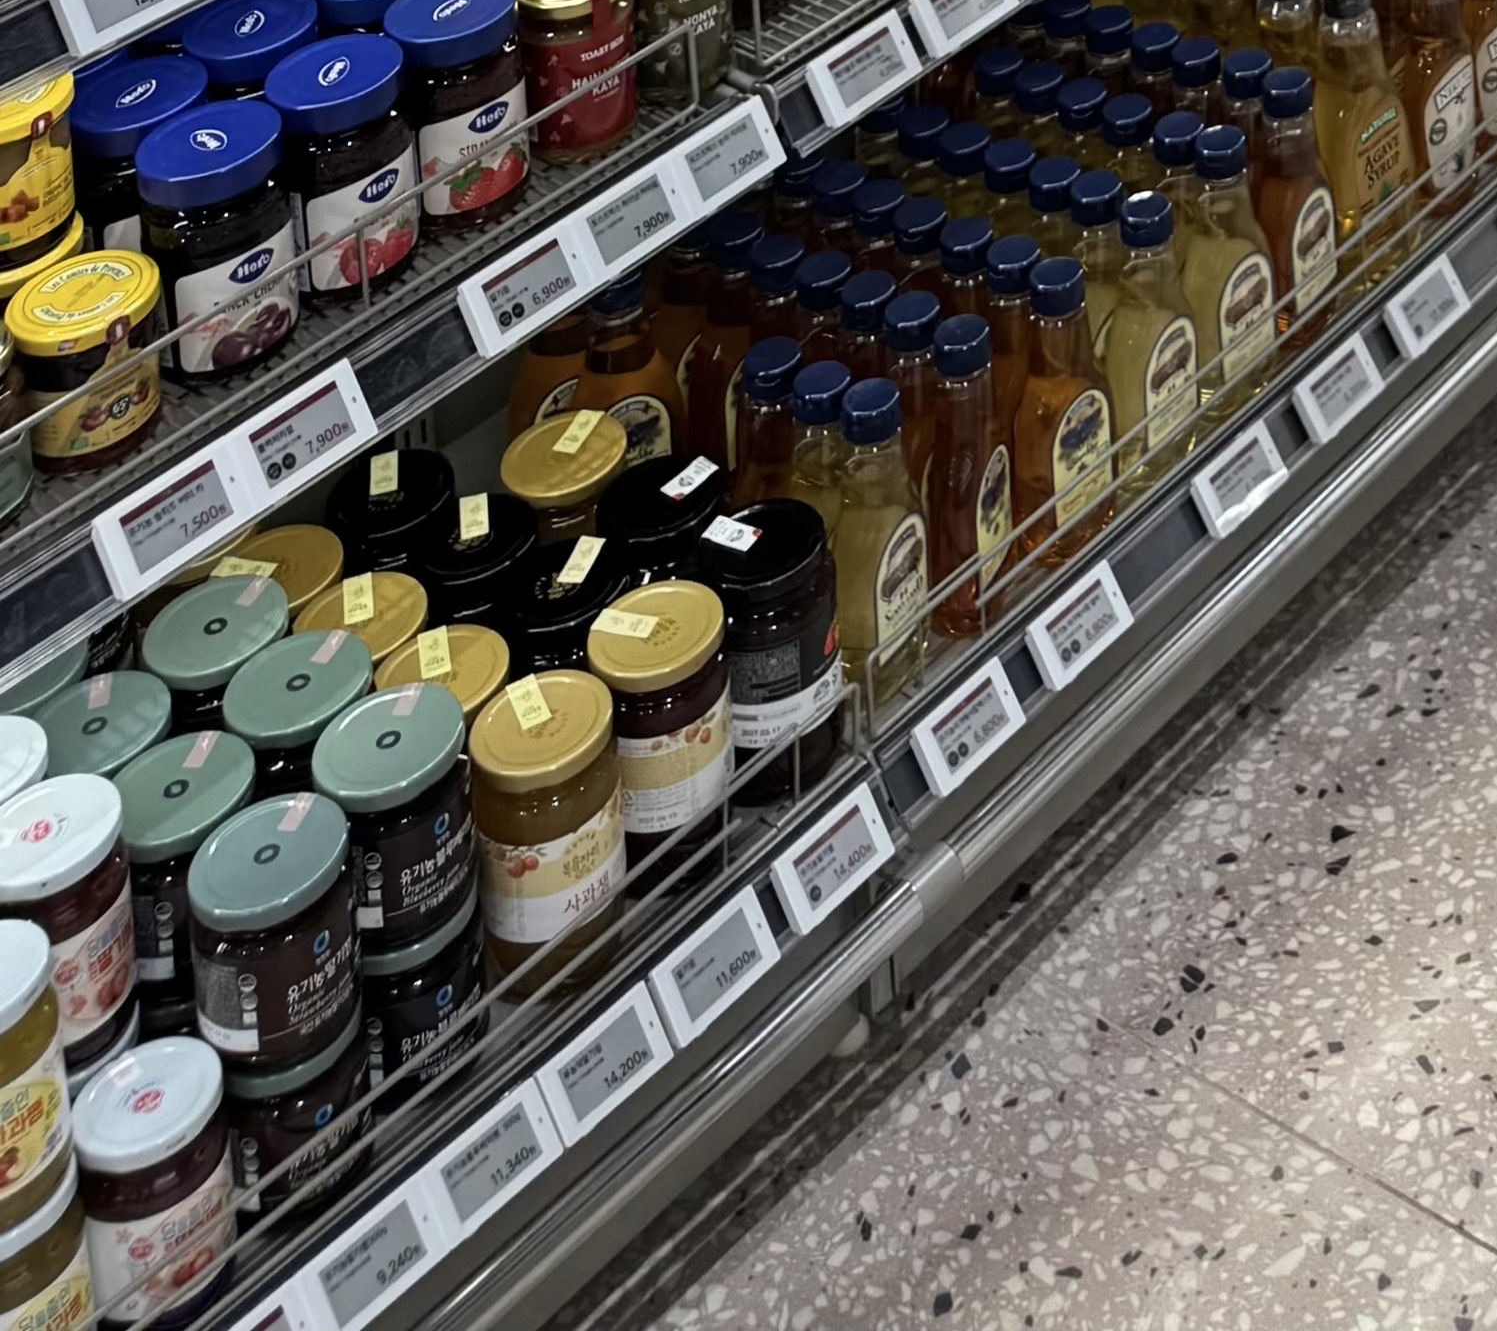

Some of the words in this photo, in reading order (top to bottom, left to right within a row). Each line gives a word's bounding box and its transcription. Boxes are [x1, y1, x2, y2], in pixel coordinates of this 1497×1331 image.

[476, 104, 508, 129] Hero
[366, 173, 398, 200] Hero
[237, 250, 271, 277] Hero
[304, 422, 350, 456] 7,900원
[714, 946, 757, 989] 11,600원
[603, 1046, 655, 1092] 14,200원
[488, 1143, 538, 1188] 11,340원
[375, 1240, 422, 1287] 9,240원
